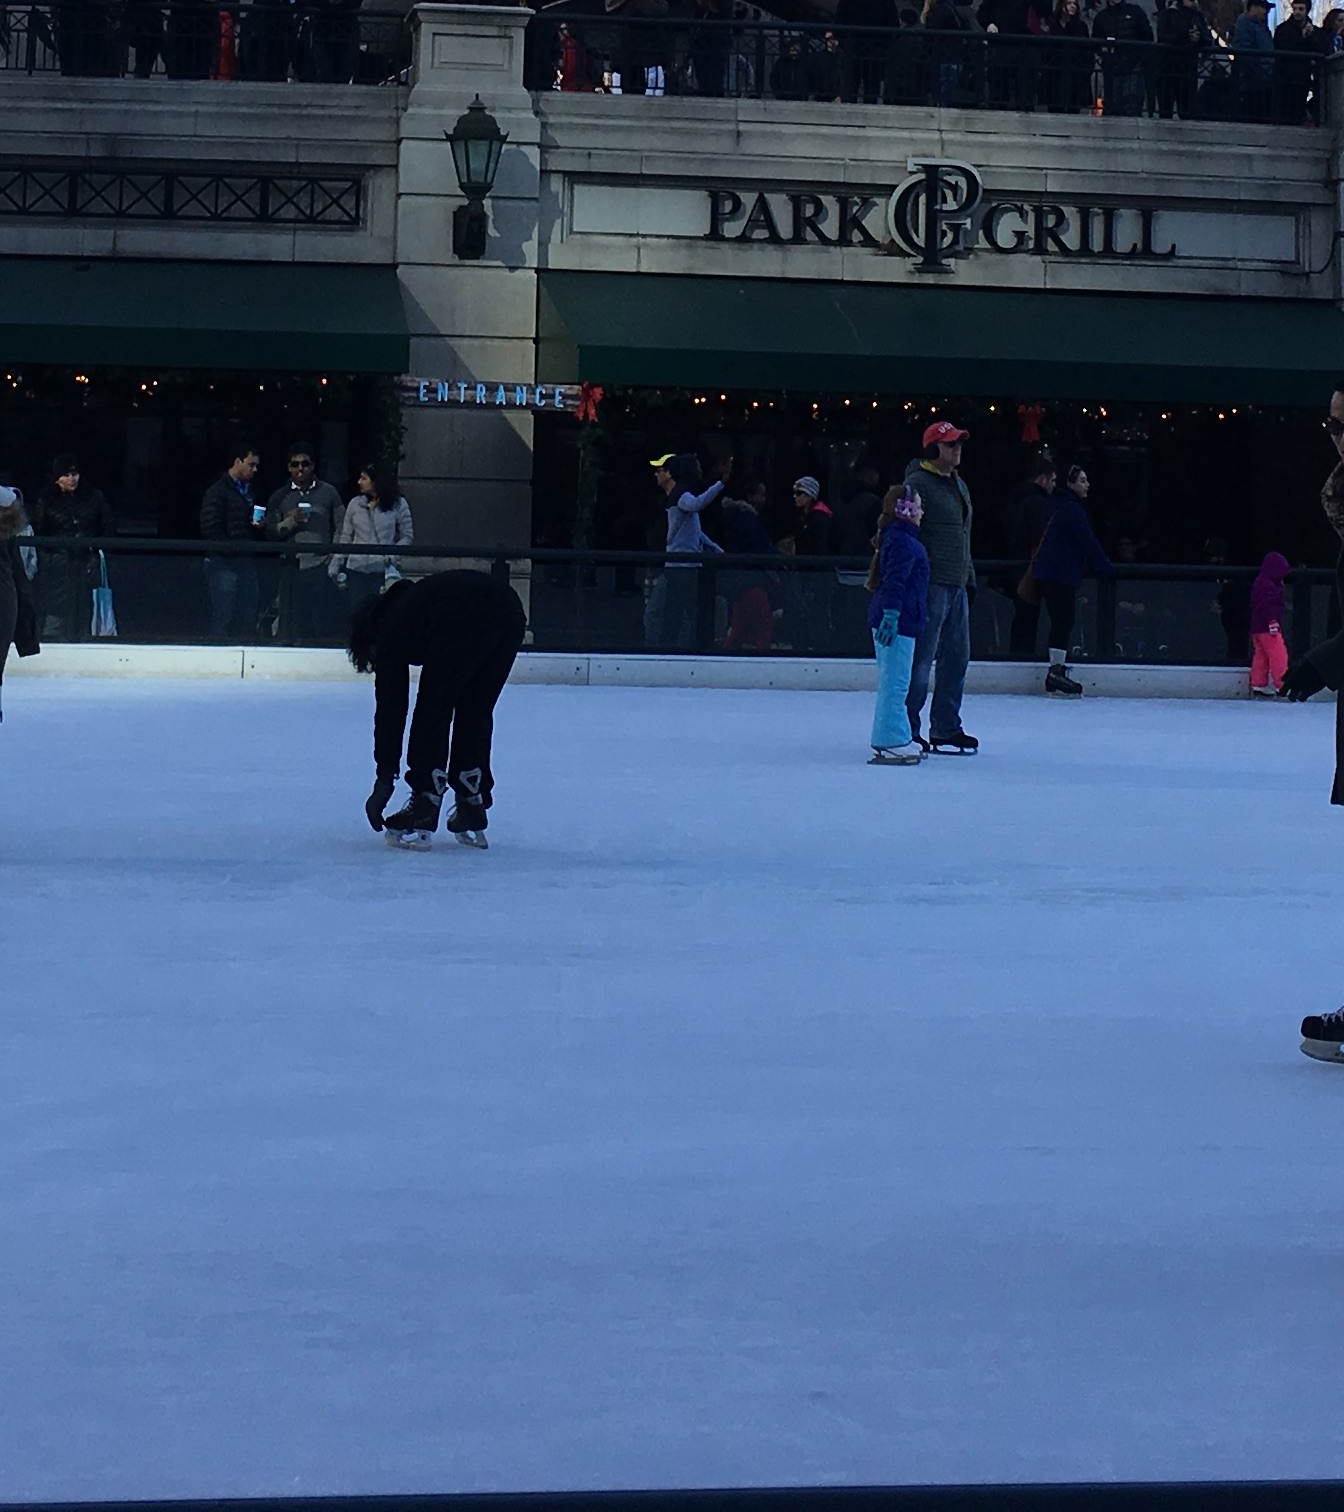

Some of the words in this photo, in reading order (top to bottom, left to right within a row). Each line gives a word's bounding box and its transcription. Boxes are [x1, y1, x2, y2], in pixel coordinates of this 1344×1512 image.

[702, 189, 881, 248] PARK
[981, 201, 1176, 258] GRILL
[418, 380, 566, 409] ENTRANCE
